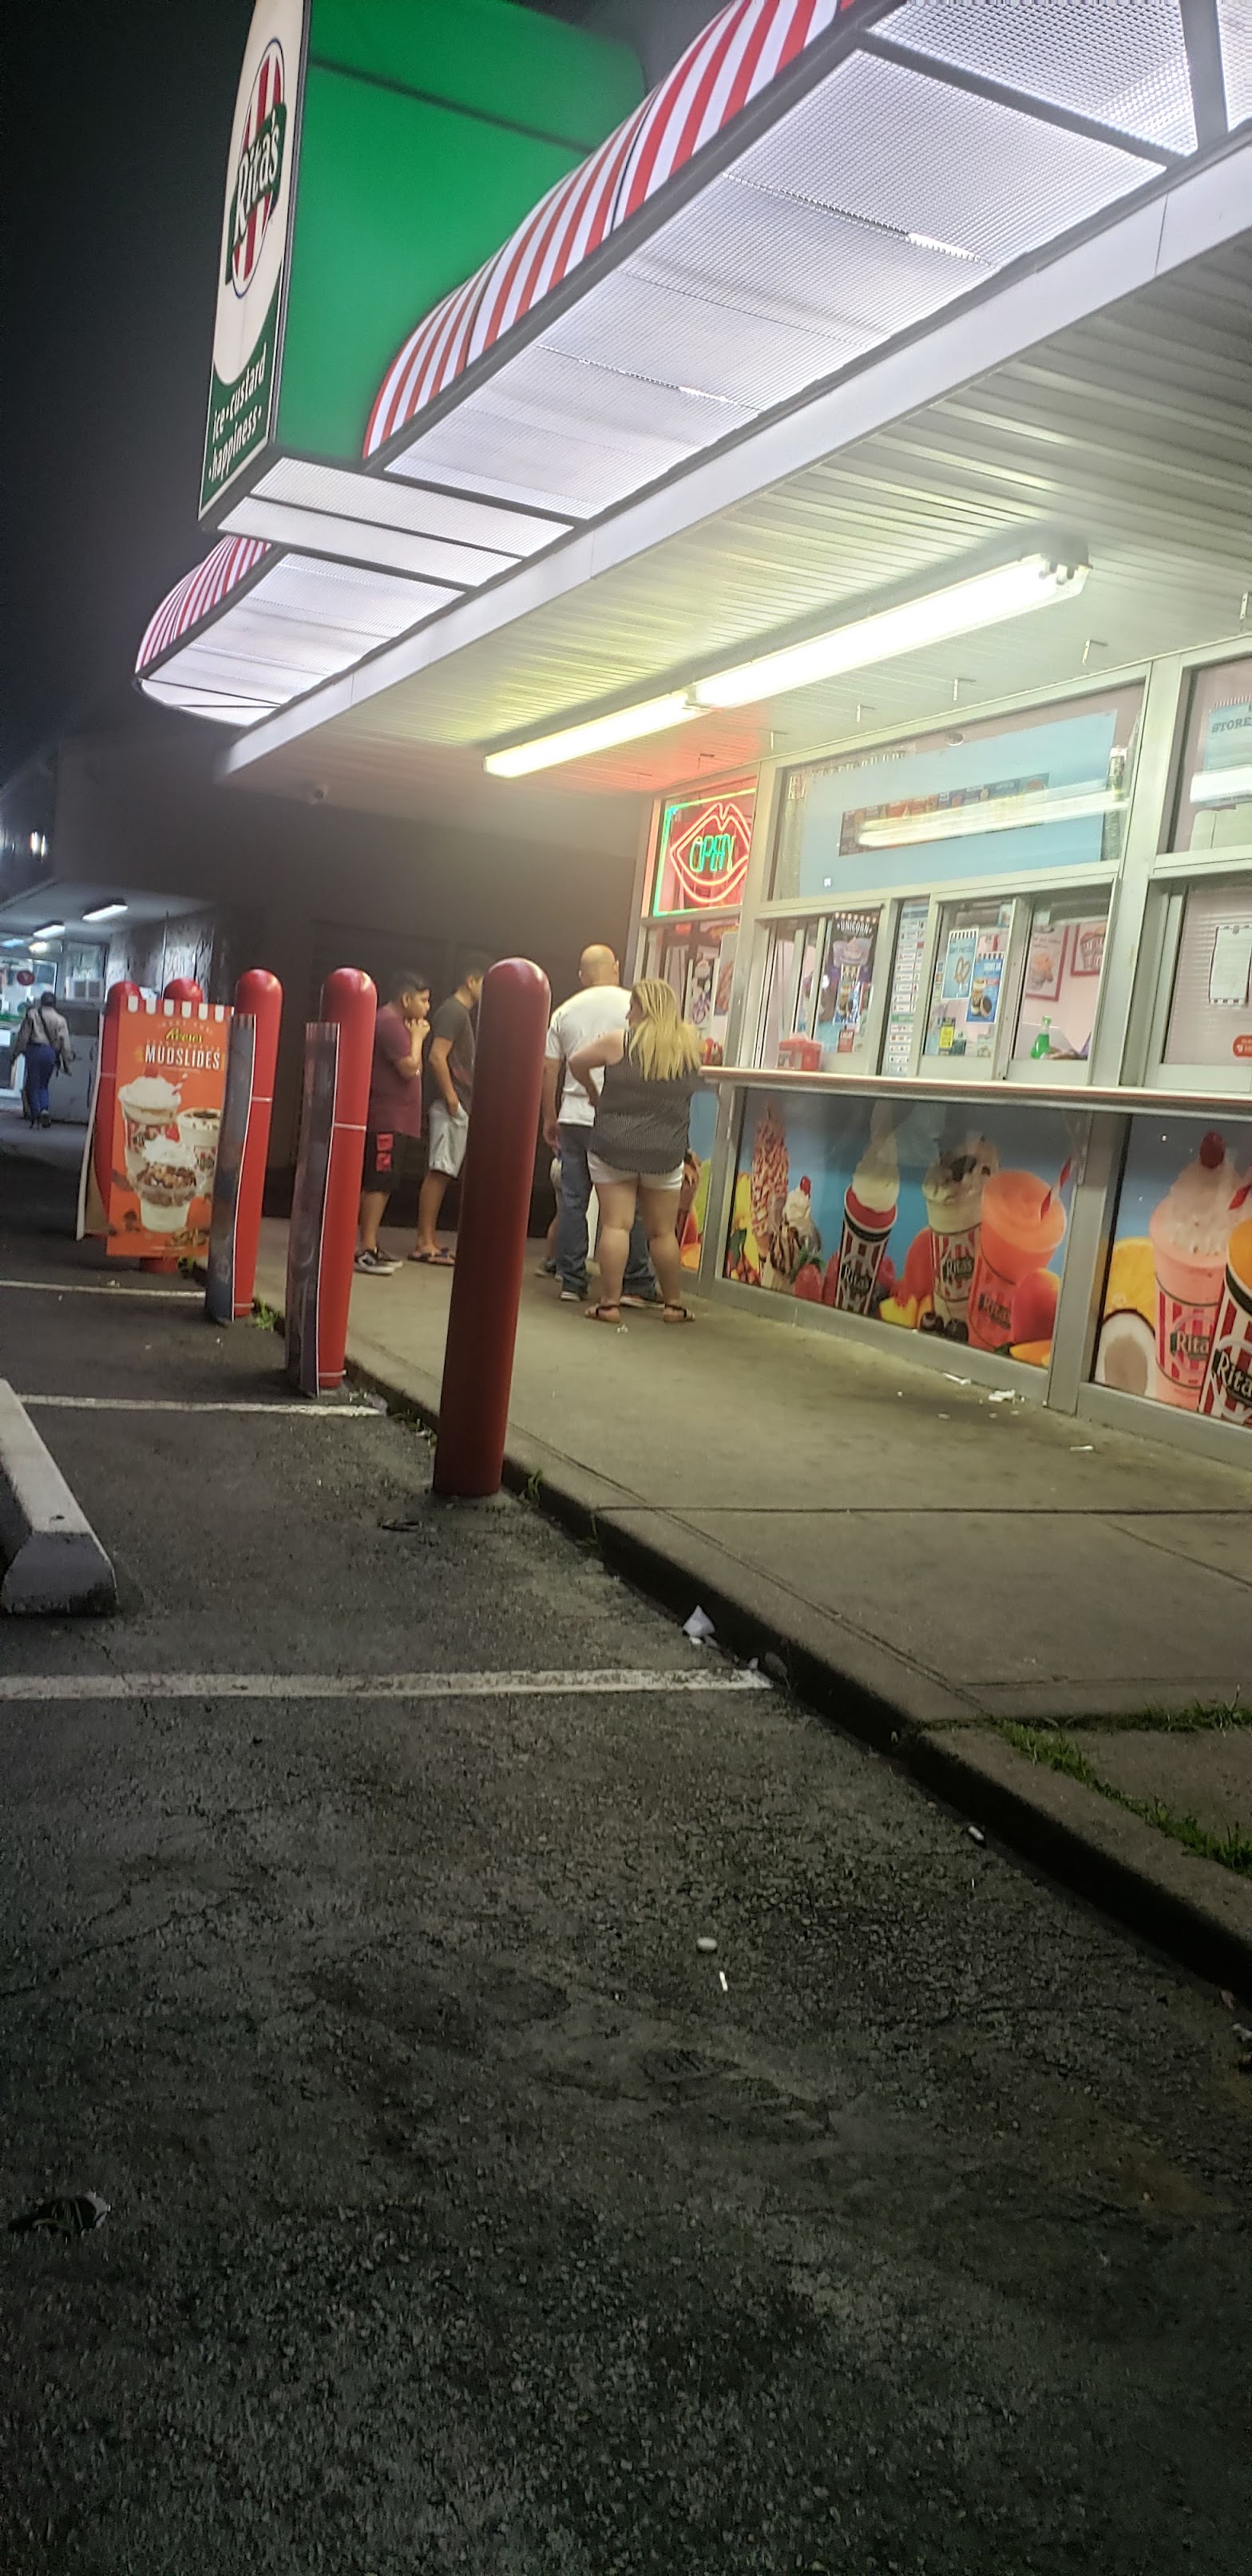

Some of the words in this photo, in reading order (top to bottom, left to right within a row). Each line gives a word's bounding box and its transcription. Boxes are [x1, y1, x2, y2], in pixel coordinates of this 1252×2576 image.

[233, 108, 279, 247] Rita's
[689, 833, 736, 874] OPEN
[841, 919, 870, 934] UNICORN
[145, 1043, 220, 1069] MUDSLIDES
